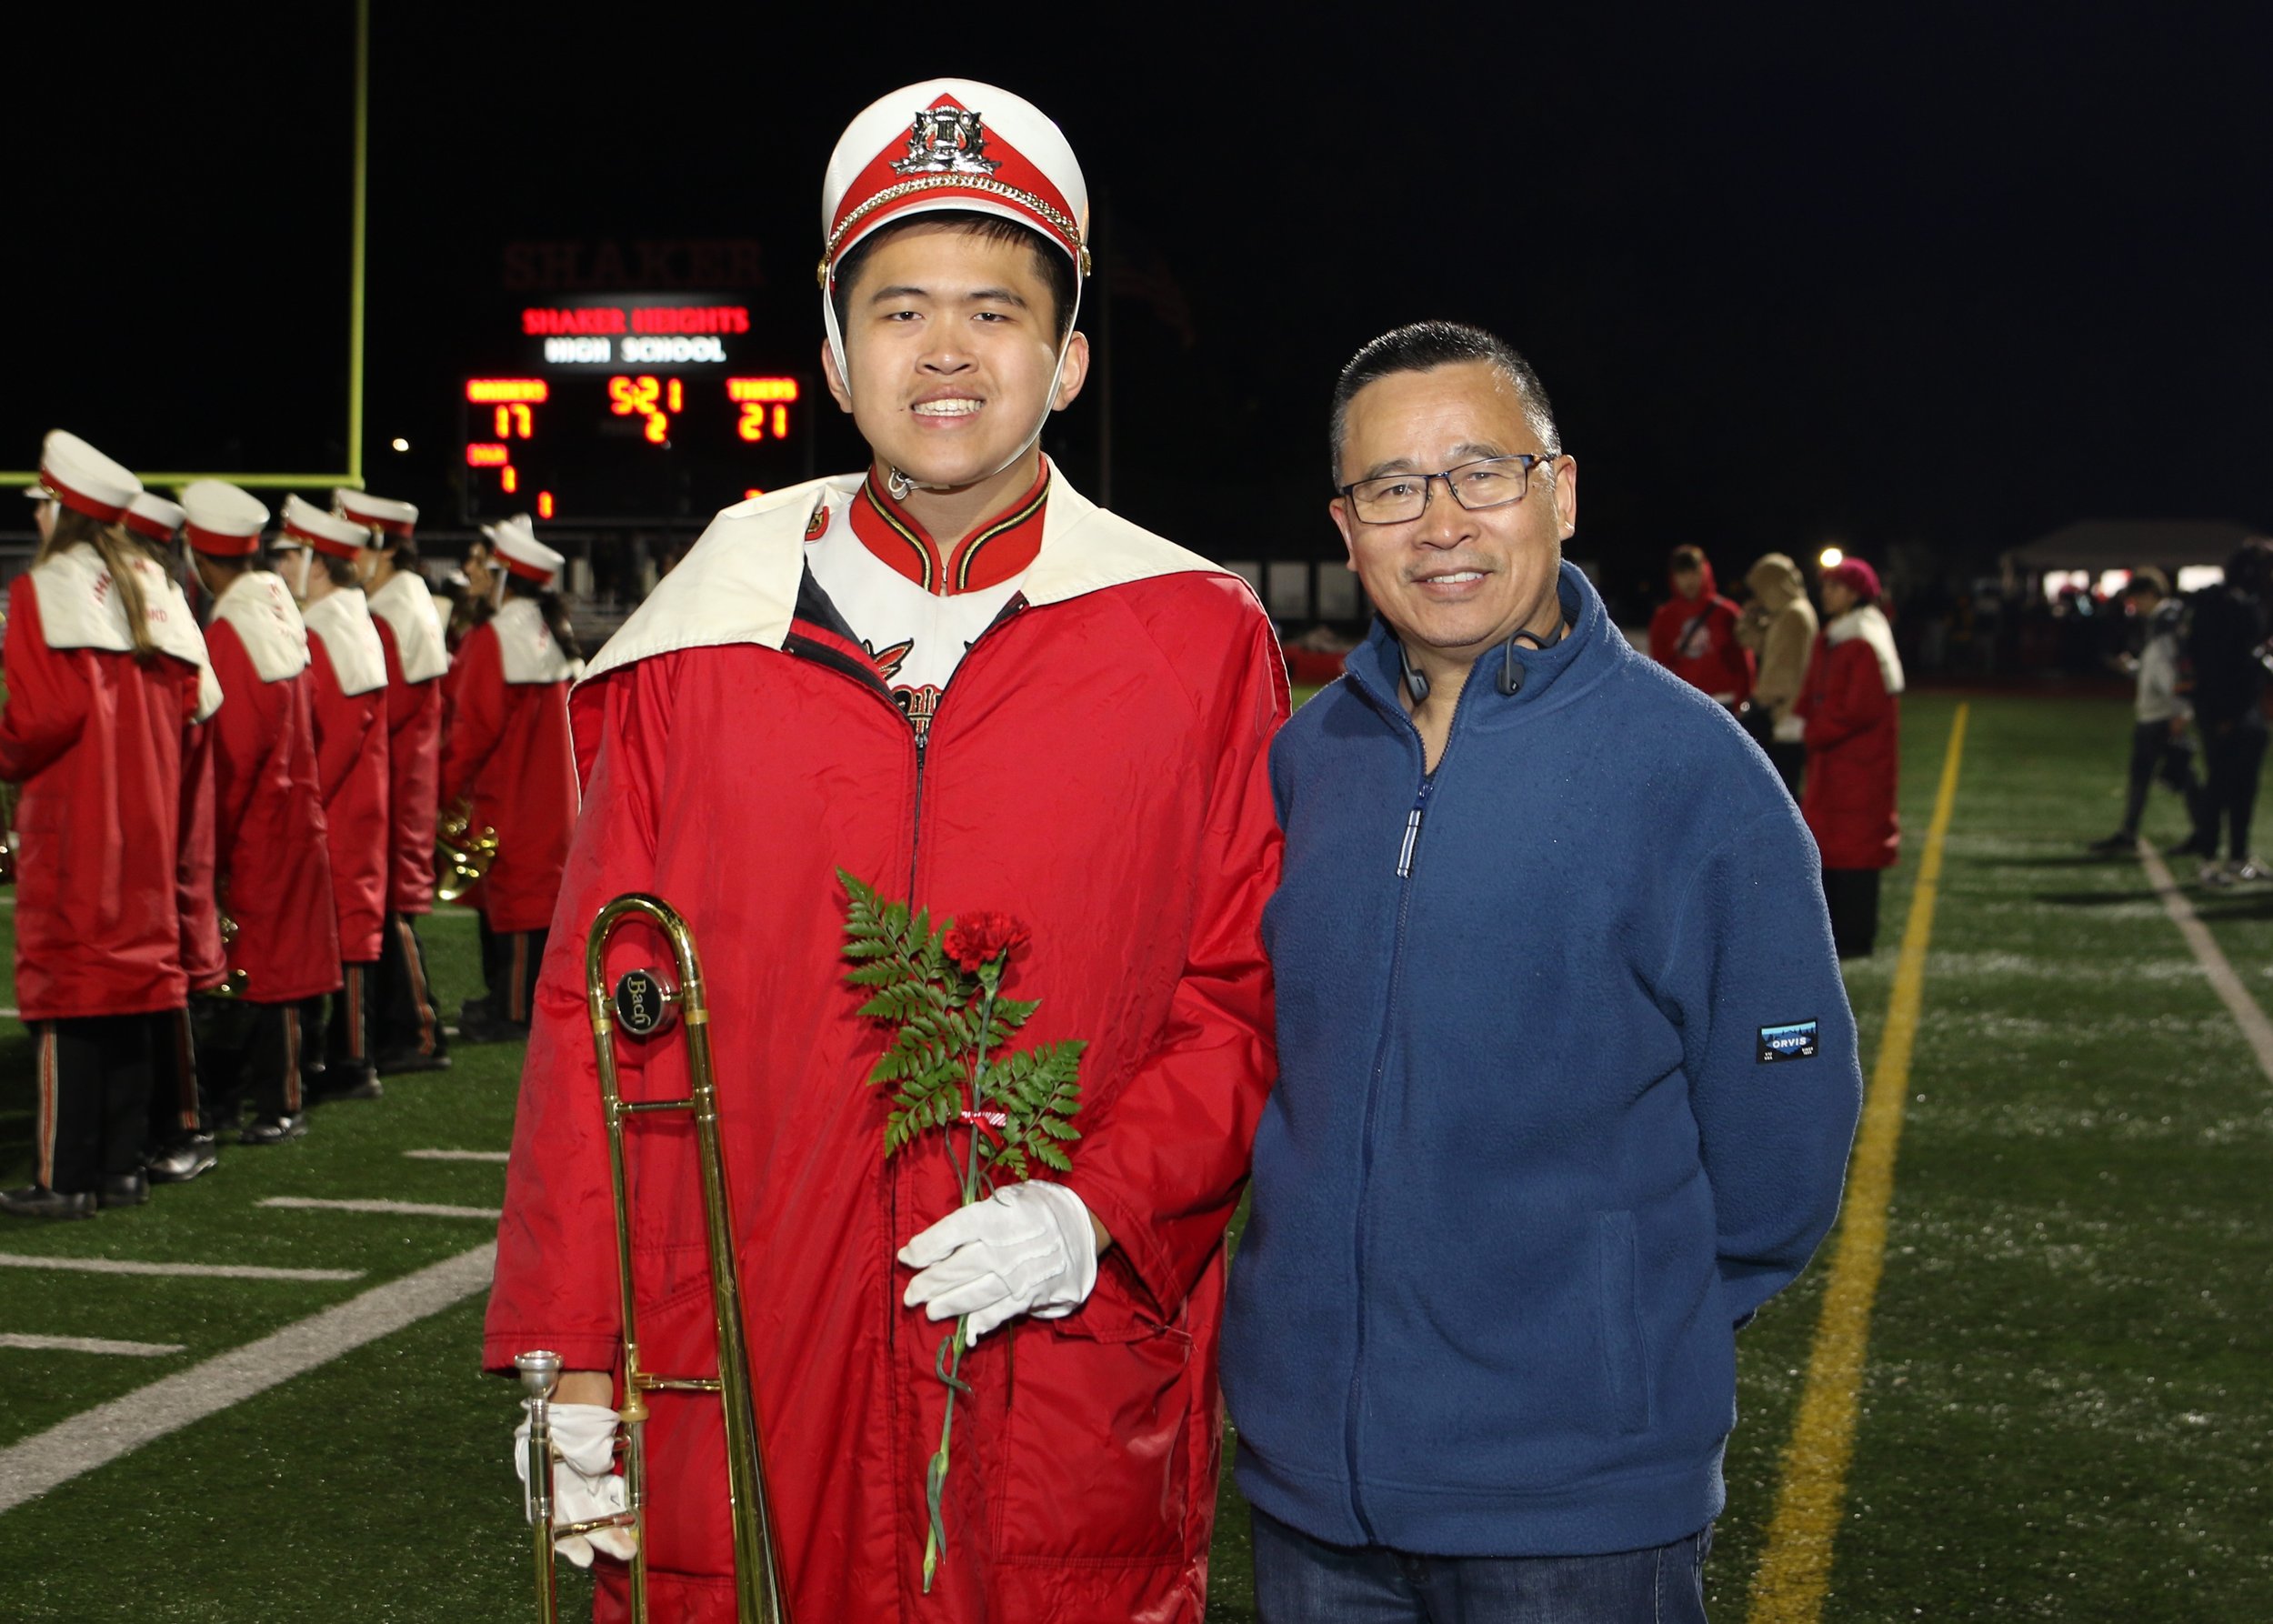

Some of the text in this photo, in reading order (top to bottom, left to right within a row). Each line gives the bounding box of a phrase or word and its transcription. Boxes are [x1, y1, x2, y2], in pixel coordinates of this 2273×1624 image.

[503, 238, 766, 291] SHAKER
[522, 306, 750, 336] SHAKER HEIGHTS
[545, 336, 727, 363] HIGH SCHOOL
[496, 403, 532, 438] 17
[645, 410, 668, 444] 2
[738, 402, 787, 440] 21
[627, 977, 652, 1026] Bach
[1772, 1037, 1807, 1048] ORVIS
